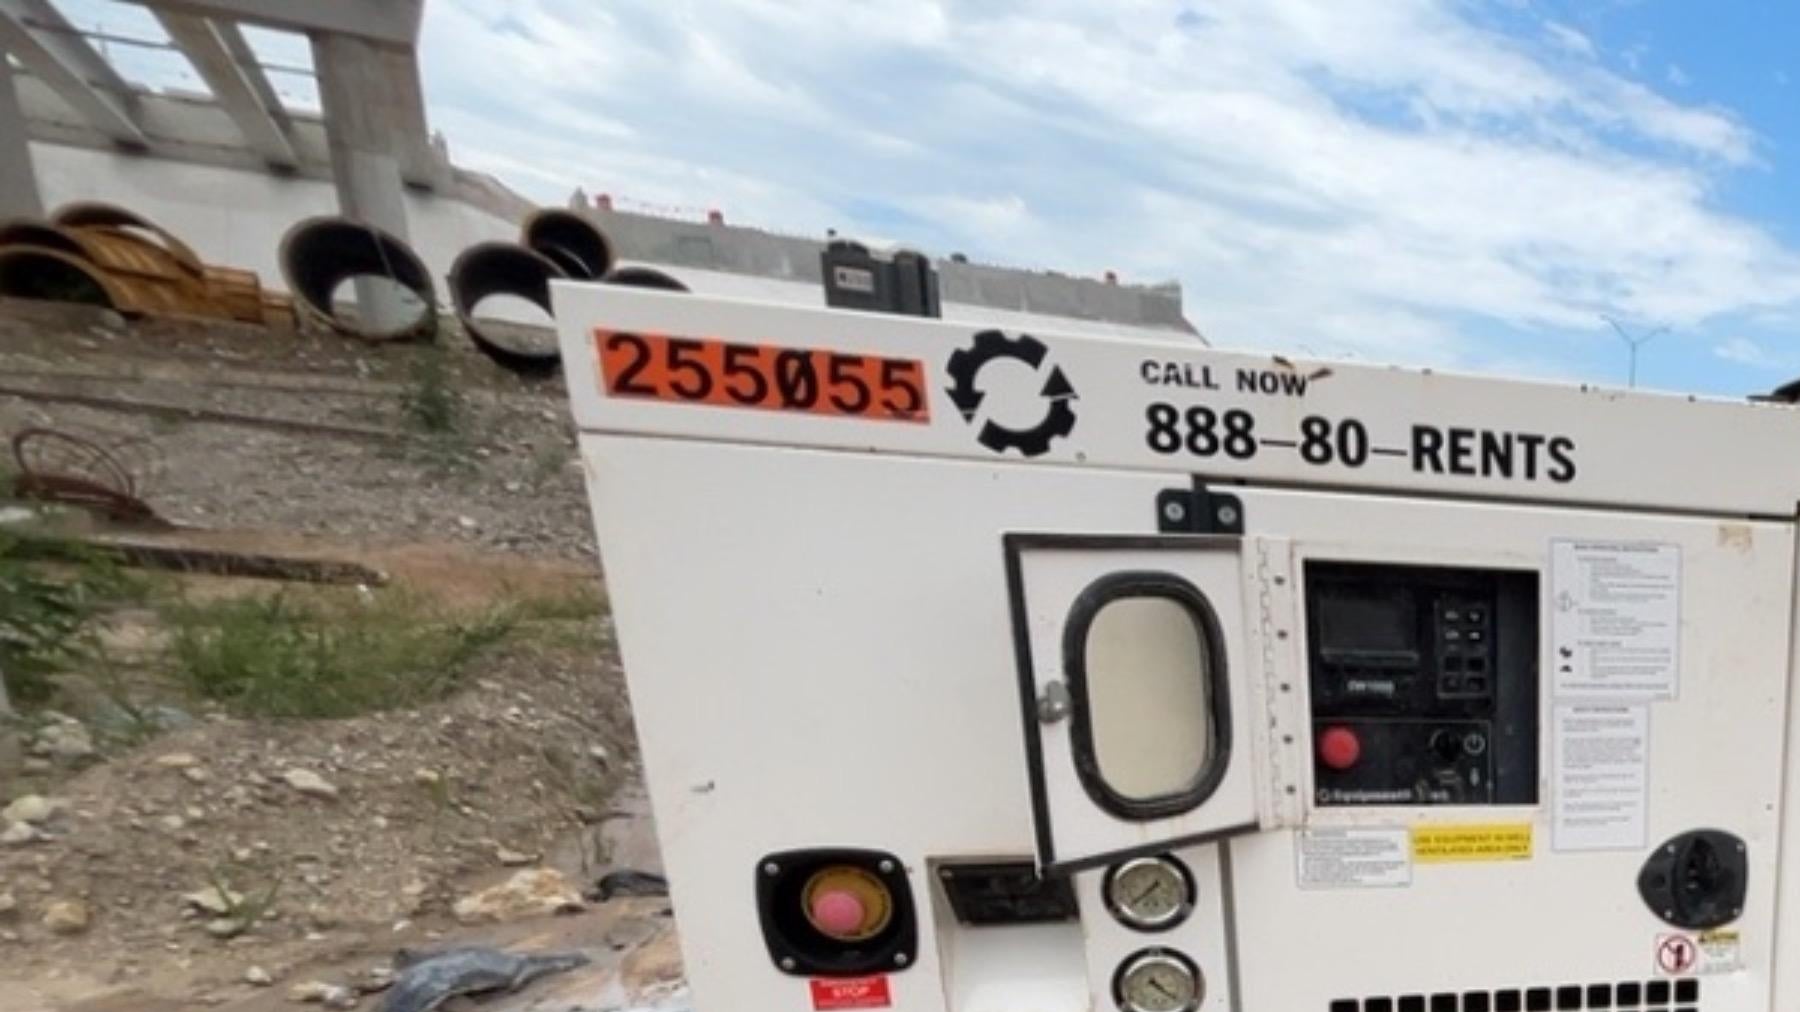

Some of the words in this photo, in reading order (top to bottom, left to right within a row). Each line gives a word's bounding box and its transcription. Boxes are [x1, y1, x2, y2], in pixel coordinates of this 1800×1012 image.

[606, 332, 924, 419] 255055
[1139, 359, 1220, 390] CALL
[1236, 367, 1309, 397] NOW
[1145, 402, 1576, 483] 888-80-RENTS
